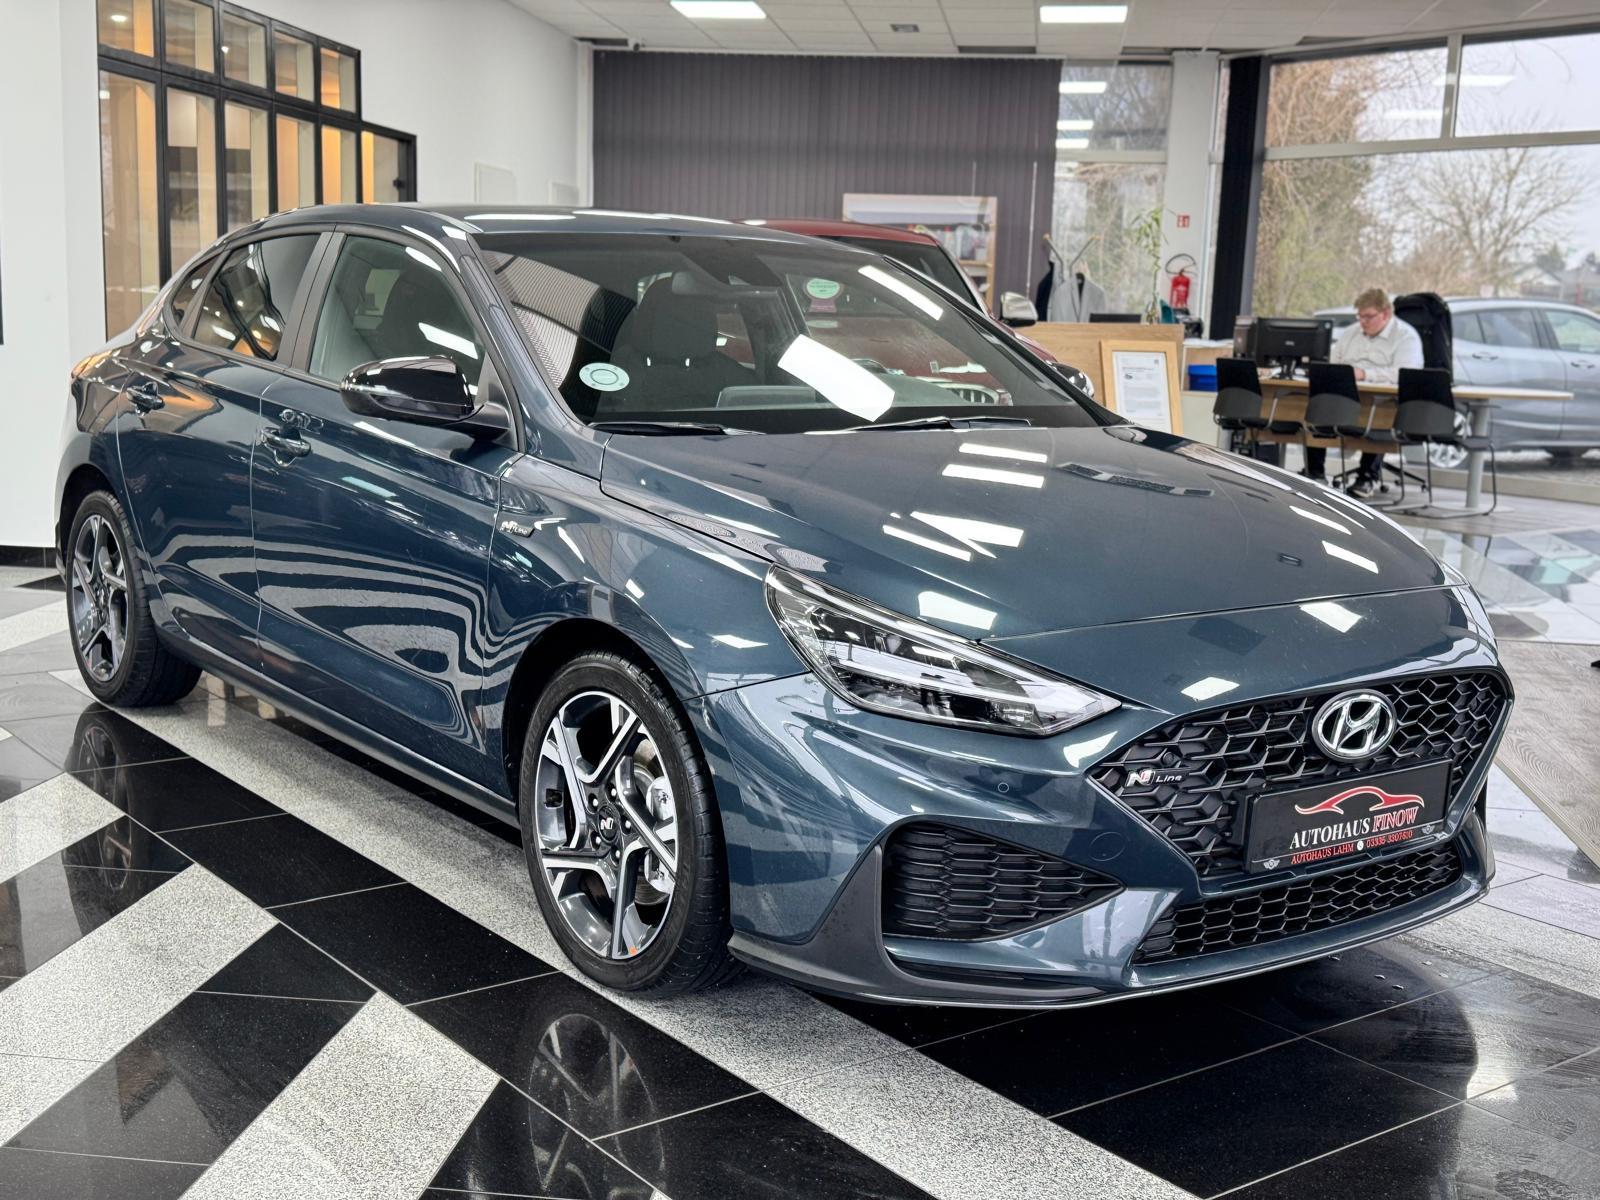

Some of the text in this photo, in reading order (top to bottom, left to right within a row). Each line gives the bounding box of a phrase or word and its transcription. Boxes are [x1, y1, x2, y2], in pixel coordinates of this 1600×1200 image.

[1156, 774, 1182, 783] Line
[1290, 806, 1419, 849] AUTOHAUS FINOW
[1291, 849, 1332, 865] AUTOHAUS
[1333, 842, 1355, 856] LAHM
